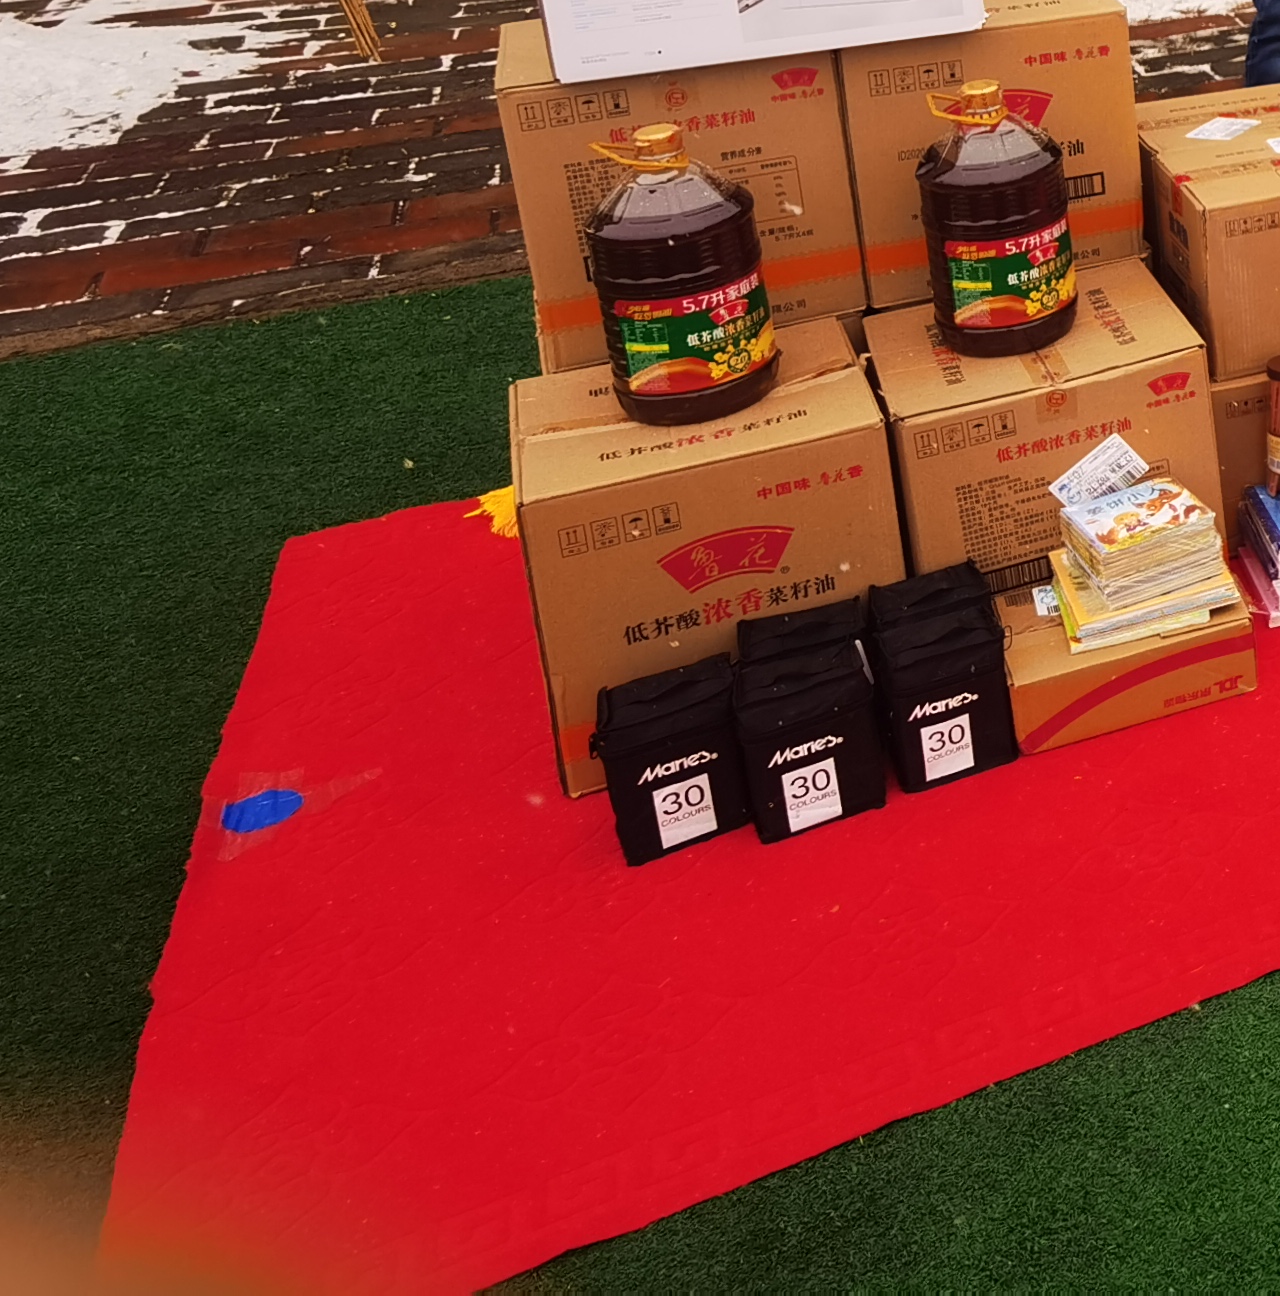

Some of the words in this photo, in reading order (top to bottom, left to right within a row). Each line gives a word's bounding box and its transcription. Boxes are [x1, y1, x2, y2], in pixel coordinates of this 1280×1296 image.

[1024, 50, 1068, 67] 中国味
[682, 272, 760, 314] 5.7升家庭装
[995, 415, 1133, 464] 低芥酸浓香菜籽油
[756, 477, 811, 501] 中国味
[688, 533, 775, 581] 鲁花
[622, 573, 837, 647] 低芥酸浓香菜籽油
[1213, 674, 1245, 695] JDL
[926, 723, 966, 753] 30
[926, 742, 971, 764] COLOURS
[789, 768, 832, 800] 30
[660, 784, 706, 816] 30
[788, 789, 838, 811] COLOURS
[660, 804, 712, 828] COLOURS
